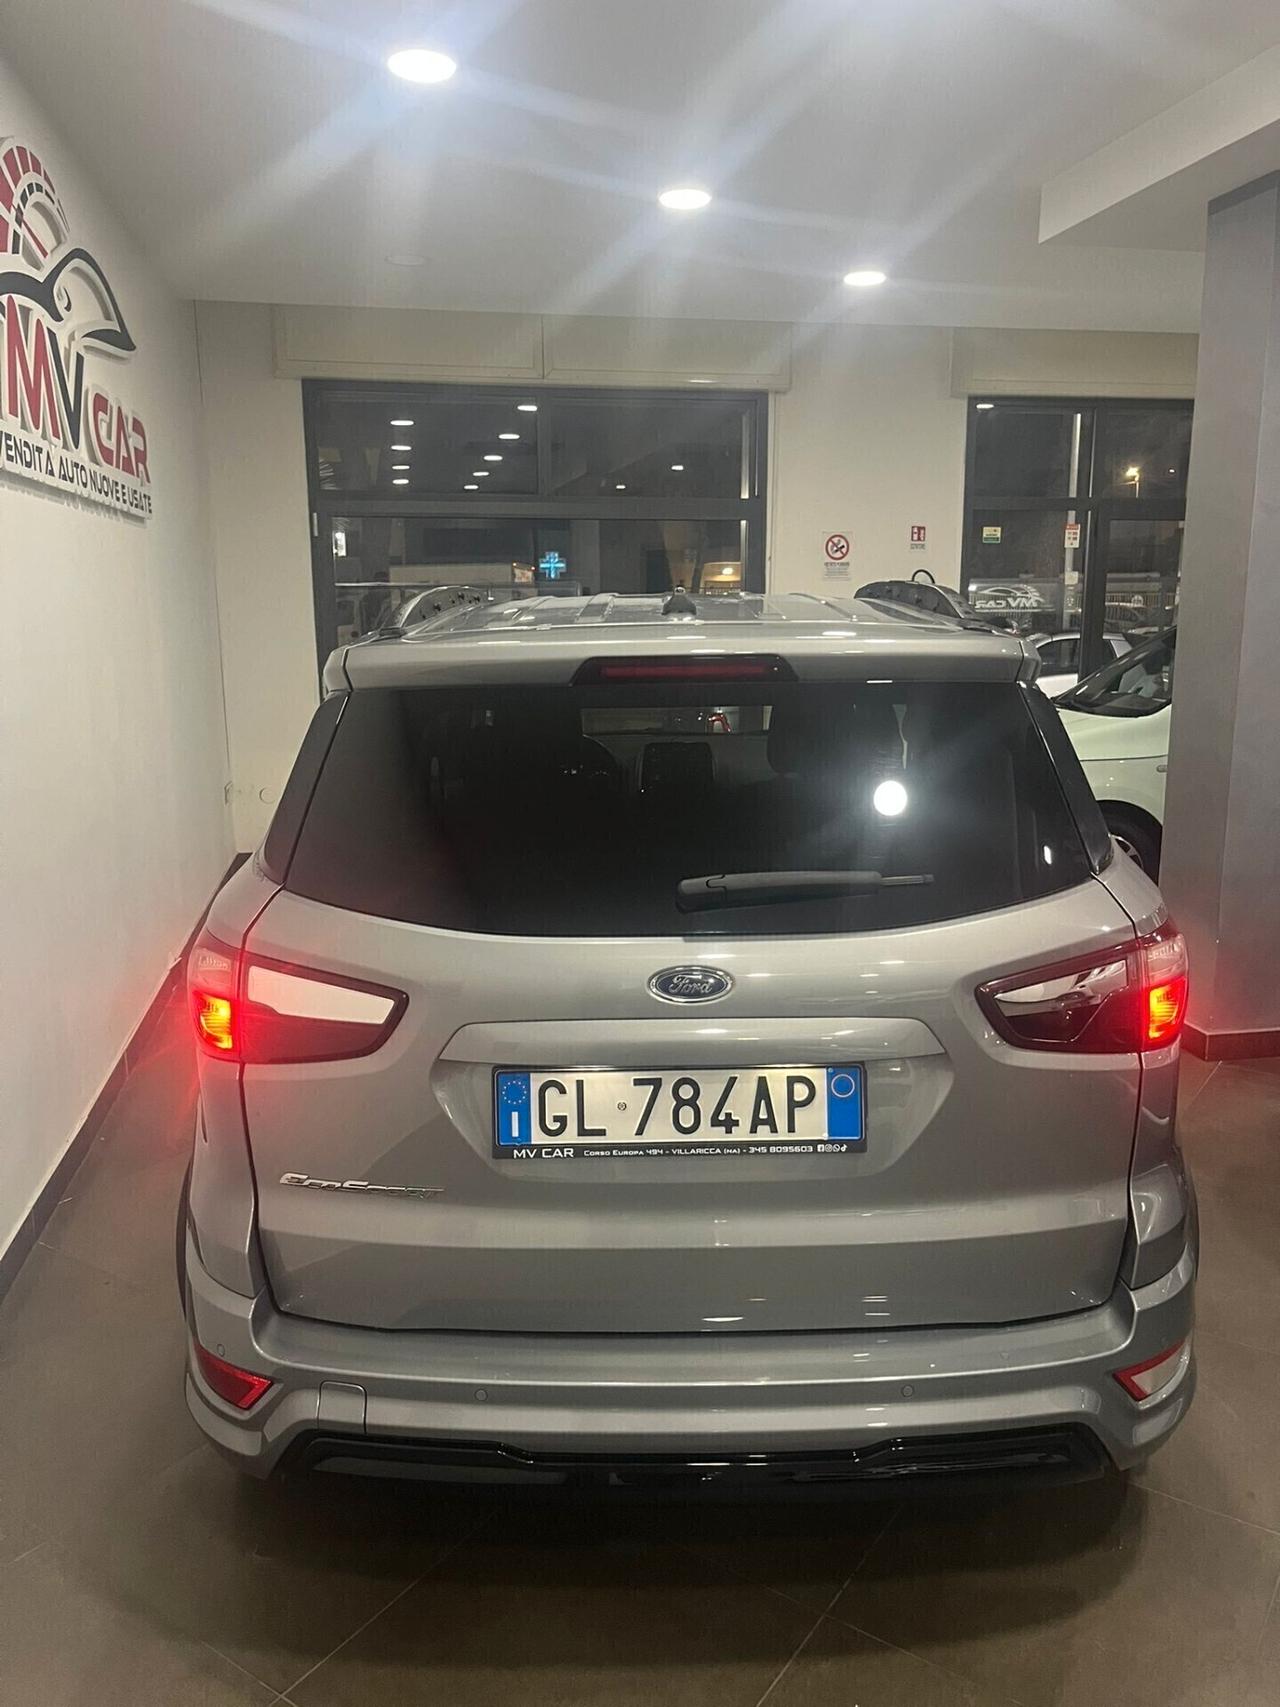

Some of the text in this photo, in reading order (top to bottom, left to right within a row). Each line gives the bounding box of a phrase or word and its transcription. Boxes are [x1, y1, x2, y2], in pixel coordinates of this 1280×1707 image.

[7, 294, 151, 484] MV CAR
[58, 455, 88, 489] AUTO
[88, 468, 120, 503] NUOVE
[127, 487, 153, 515] USATE
[668, 974, 715, 994] Ford
[538, 1075, 817, 1138] GL 784AP
[513, 1147, 575, 1160] MV CAR
[671, 1147, 722, 1156] VILLARICCA
